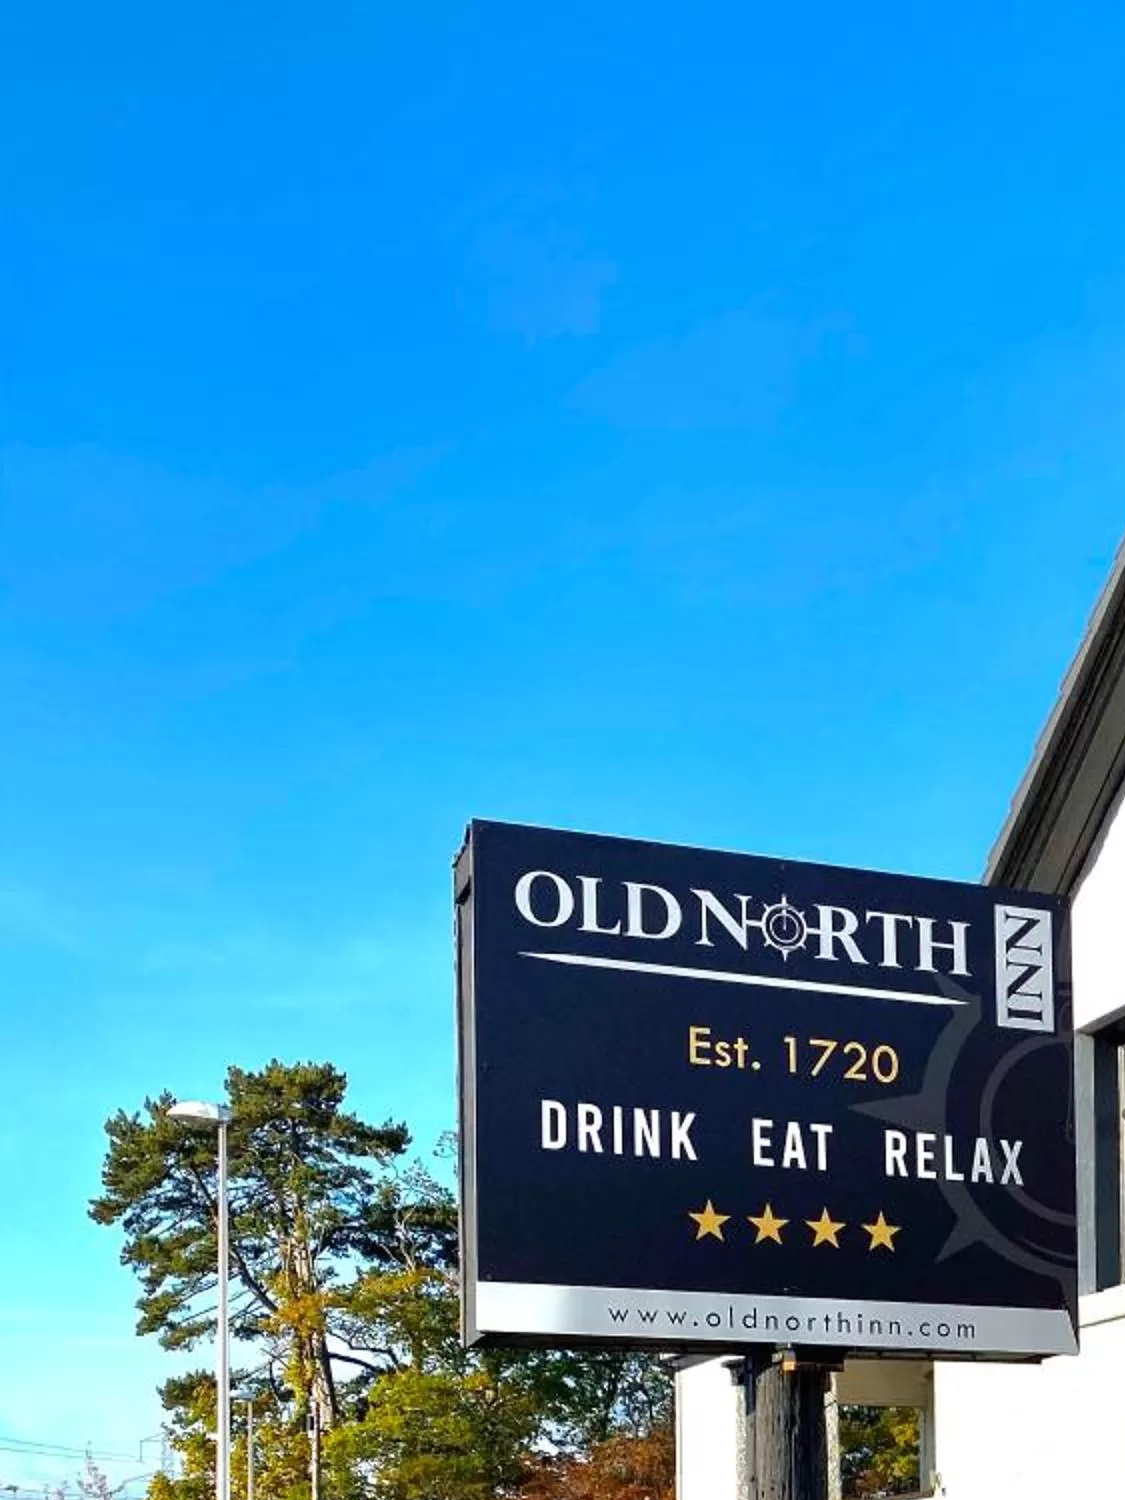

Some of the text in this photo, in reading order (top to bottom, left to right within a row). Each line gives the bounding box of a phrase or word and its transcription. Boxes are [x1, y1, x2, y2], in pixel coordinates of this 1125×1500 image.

[1005, 912, 1044, 1023] INN
[688, 1026, 899, 1083] Est. 1720
[541, 1099, 1024, 1186] DRINK EAT RELAX
[608, 1306, 976, 1339] www.oldnorthinn.com
